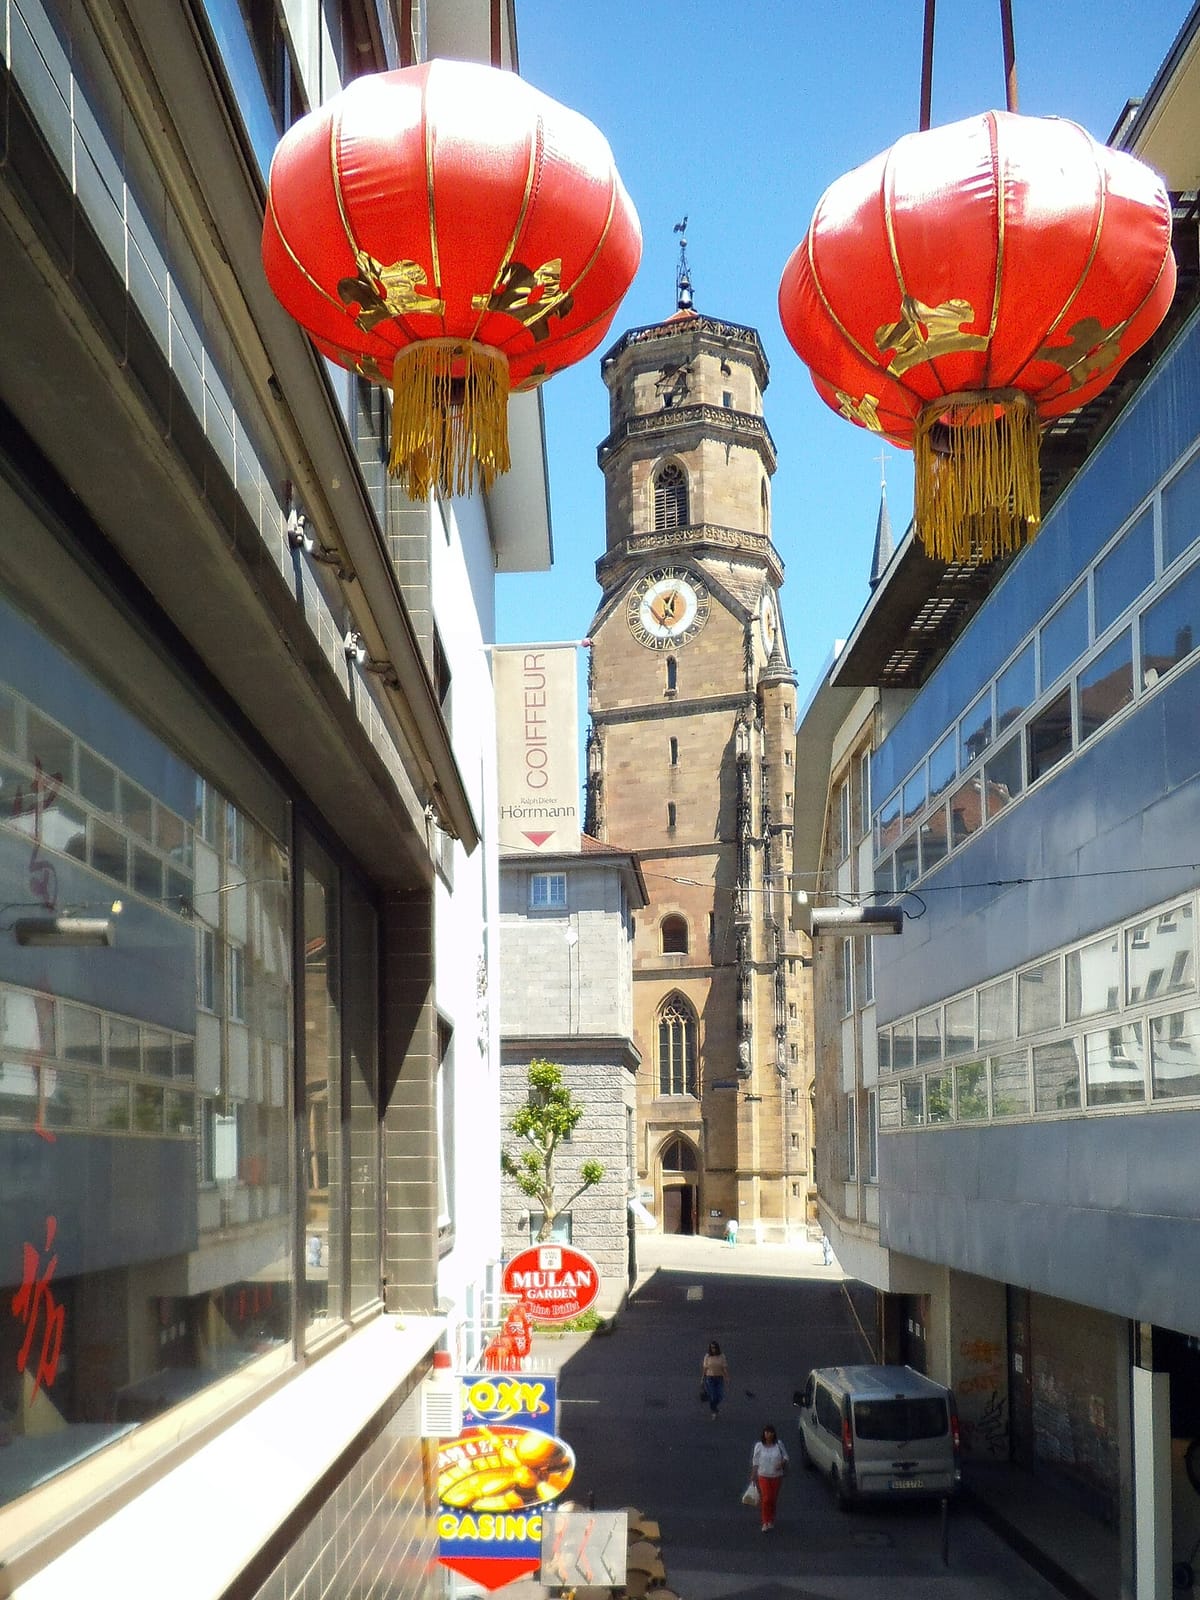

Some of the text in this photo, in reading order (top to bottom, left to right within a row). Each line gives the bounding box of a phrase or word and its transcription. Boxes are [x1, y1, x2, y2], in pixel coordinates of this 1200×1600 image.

[524, 653, 549, 789] COIFFEUR
[500, 804, 576, 820] Hörrmann
[512, 1270, 593, 1288] MULAN
[526, 1288, 578, 1299] GARDEN
[462, 1381, 546, 1413] OXY
